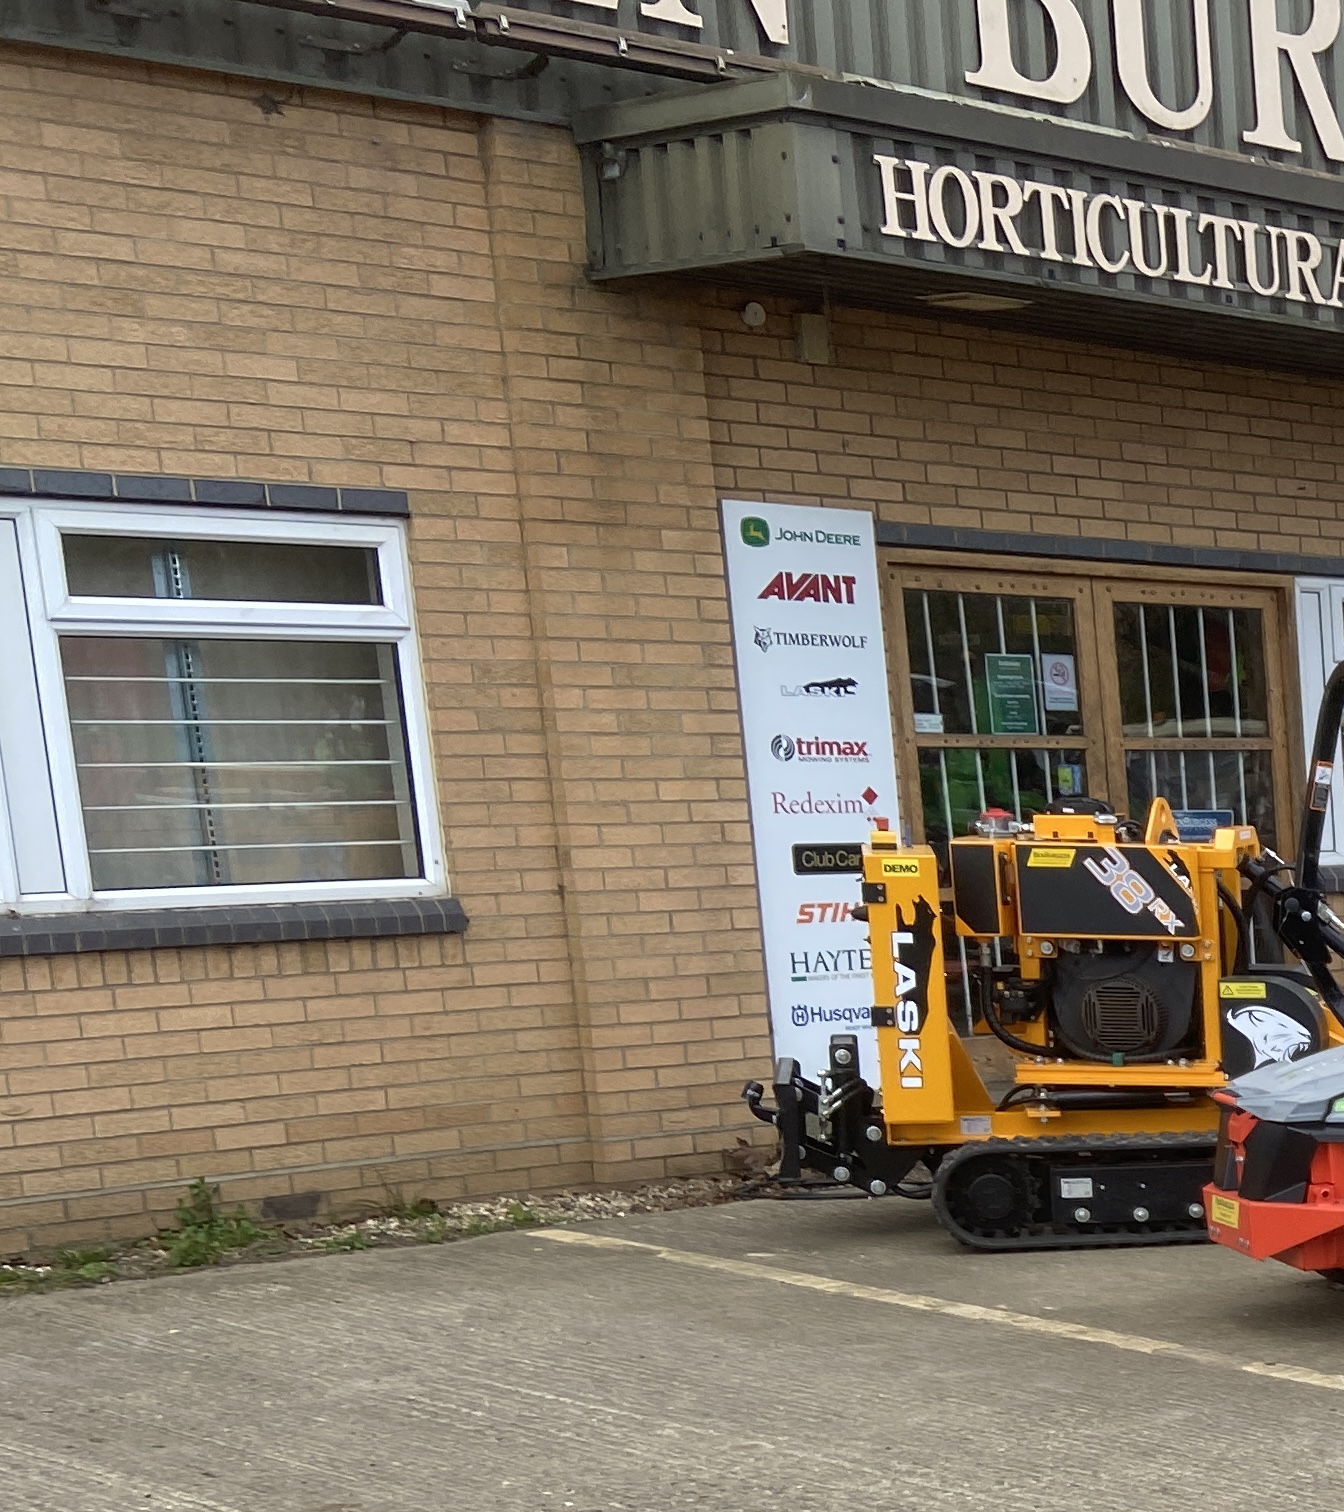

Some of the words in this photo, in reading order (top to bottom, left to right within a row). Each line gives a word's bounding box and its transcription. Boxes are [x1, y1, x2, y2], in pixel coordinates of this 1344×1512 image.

[775, 527, 813, 542] JOHN
[814, 530, 861, 546] DEERE
[757, 571, 857, 605] AVANT
[773, 631, 868, 649] TIMBERWOLF
[795, 736, 869, 757] trimax
[771, 791, 864, 814] Redexim
[801, 851, 835, 867] Club
[835, 851, 861, 867] Car
[883, 863, 919, 875] DEMO
[797, 902, 858, 924] STIH
[790, 948, 873, 973] HAYTE
[810, 1006, 871, 1023] Husqva
[890, 930, 924, 1089] LASKI
